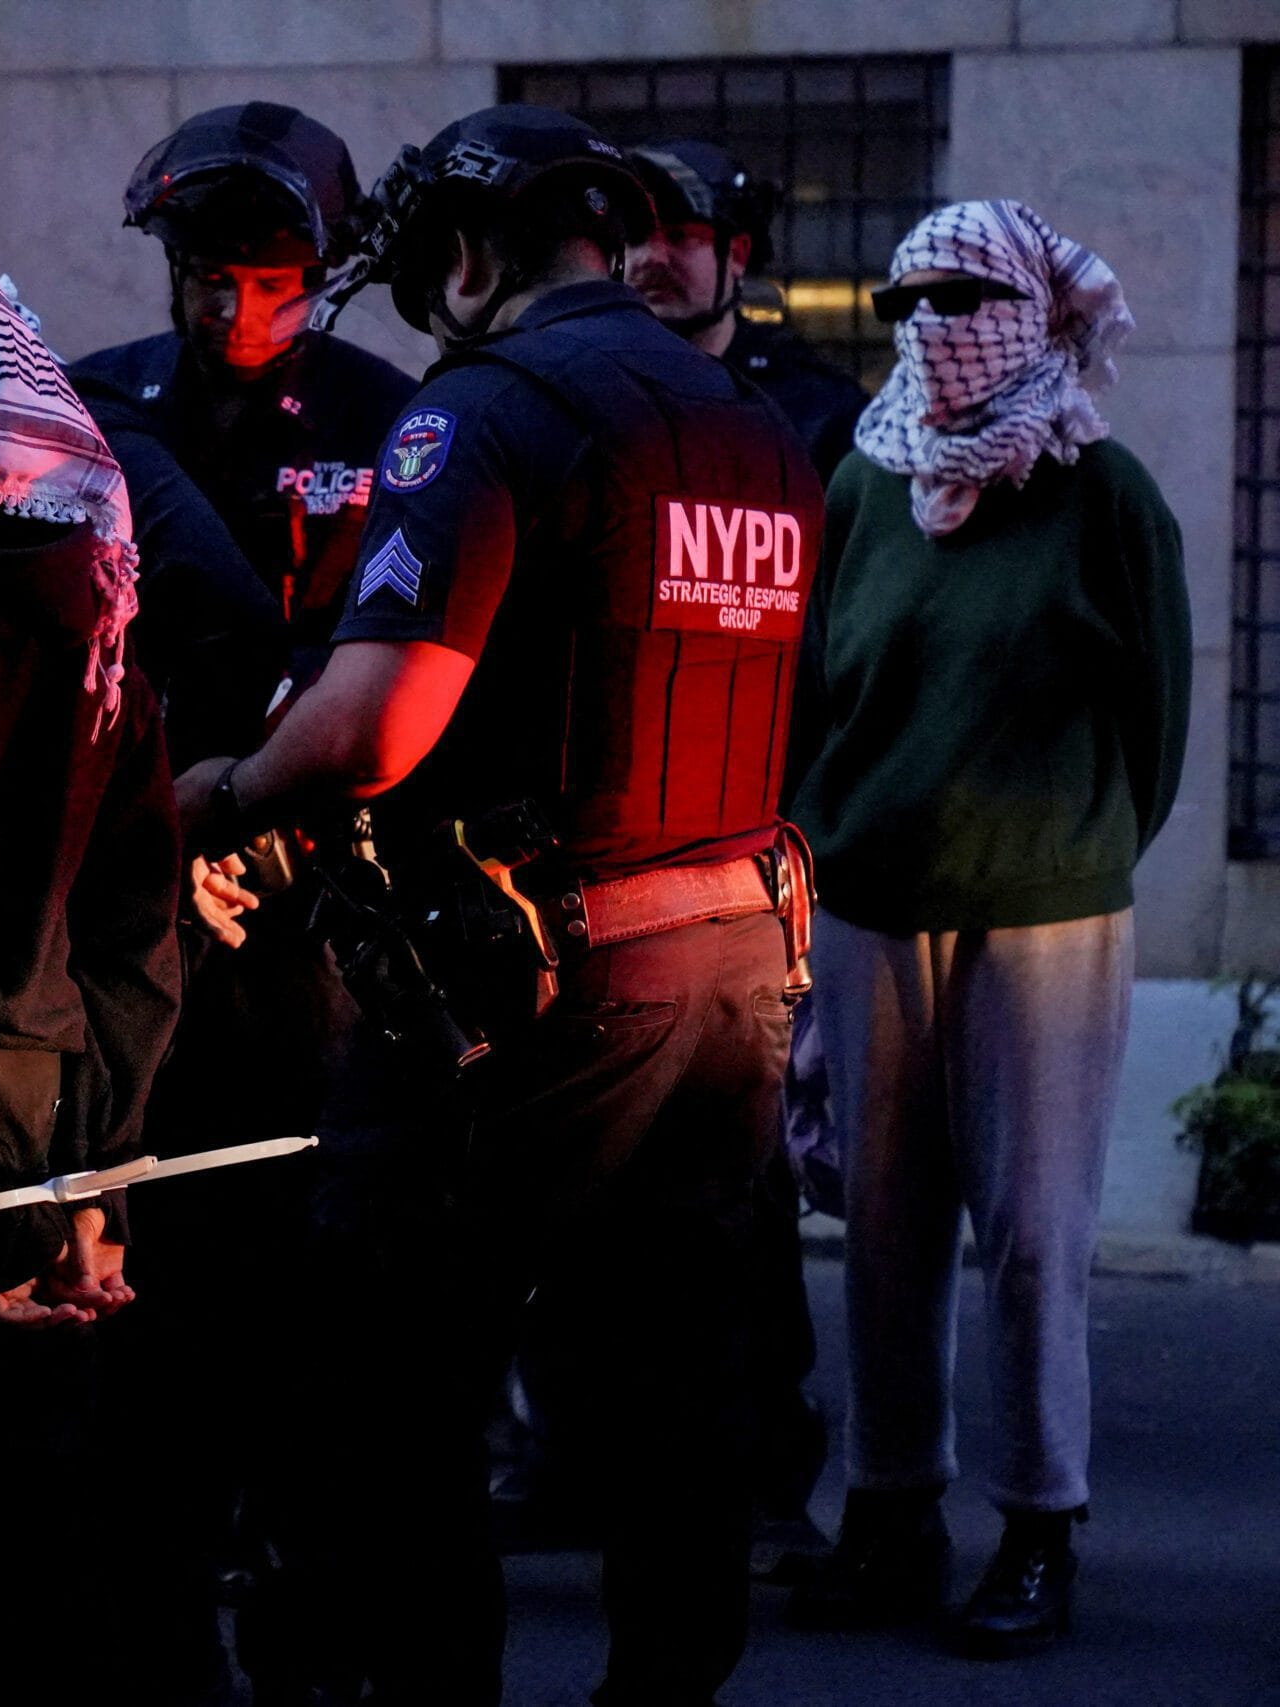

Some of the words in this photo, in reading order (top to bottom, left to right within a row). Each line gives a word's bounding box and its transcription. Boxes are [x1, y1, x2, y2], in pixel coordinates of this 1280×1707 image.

[400, 413, 448, 437] POLICE
[277, 467, 373, 495] POLICE
[669, 502, 801, 587] NYPD
[658, 580, 741, 607] STRATEGIC
[745, 586, 800, 612] RESPONSE
[719, 606, 761, 630] GROUP
